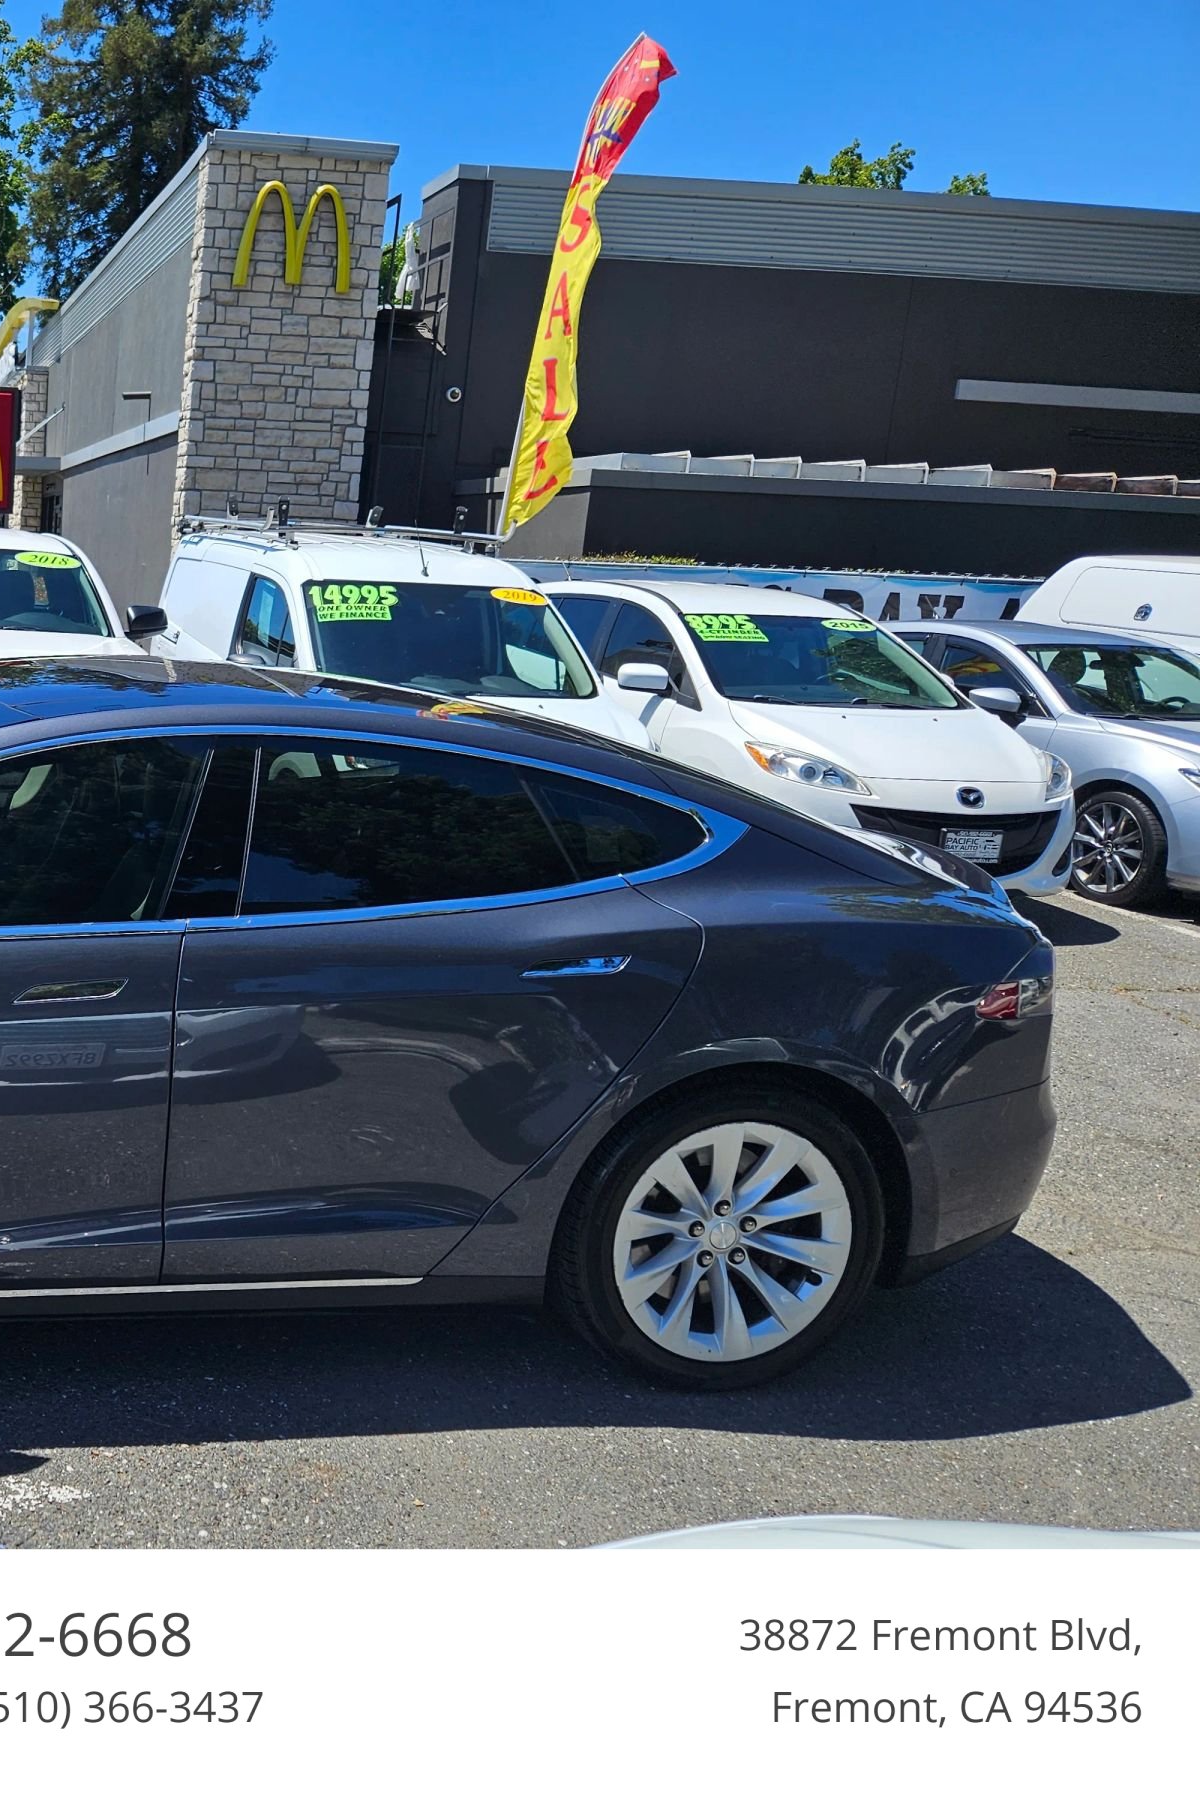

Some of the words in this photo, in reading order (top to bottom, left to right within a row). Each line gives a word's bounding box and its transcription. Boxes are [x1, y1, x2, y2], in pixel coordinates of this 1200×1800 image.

[28, 554, 70, 565] 2018
[308, 584, 399, 607] 14995
[503, 590, 537, 602] 2019
[345, 604, 387, 612] OWNER
[319, 612, 336, 620] WE
[684, 614, 757, 630] 8995
[946, 837, 980, 845] PACIFIC
